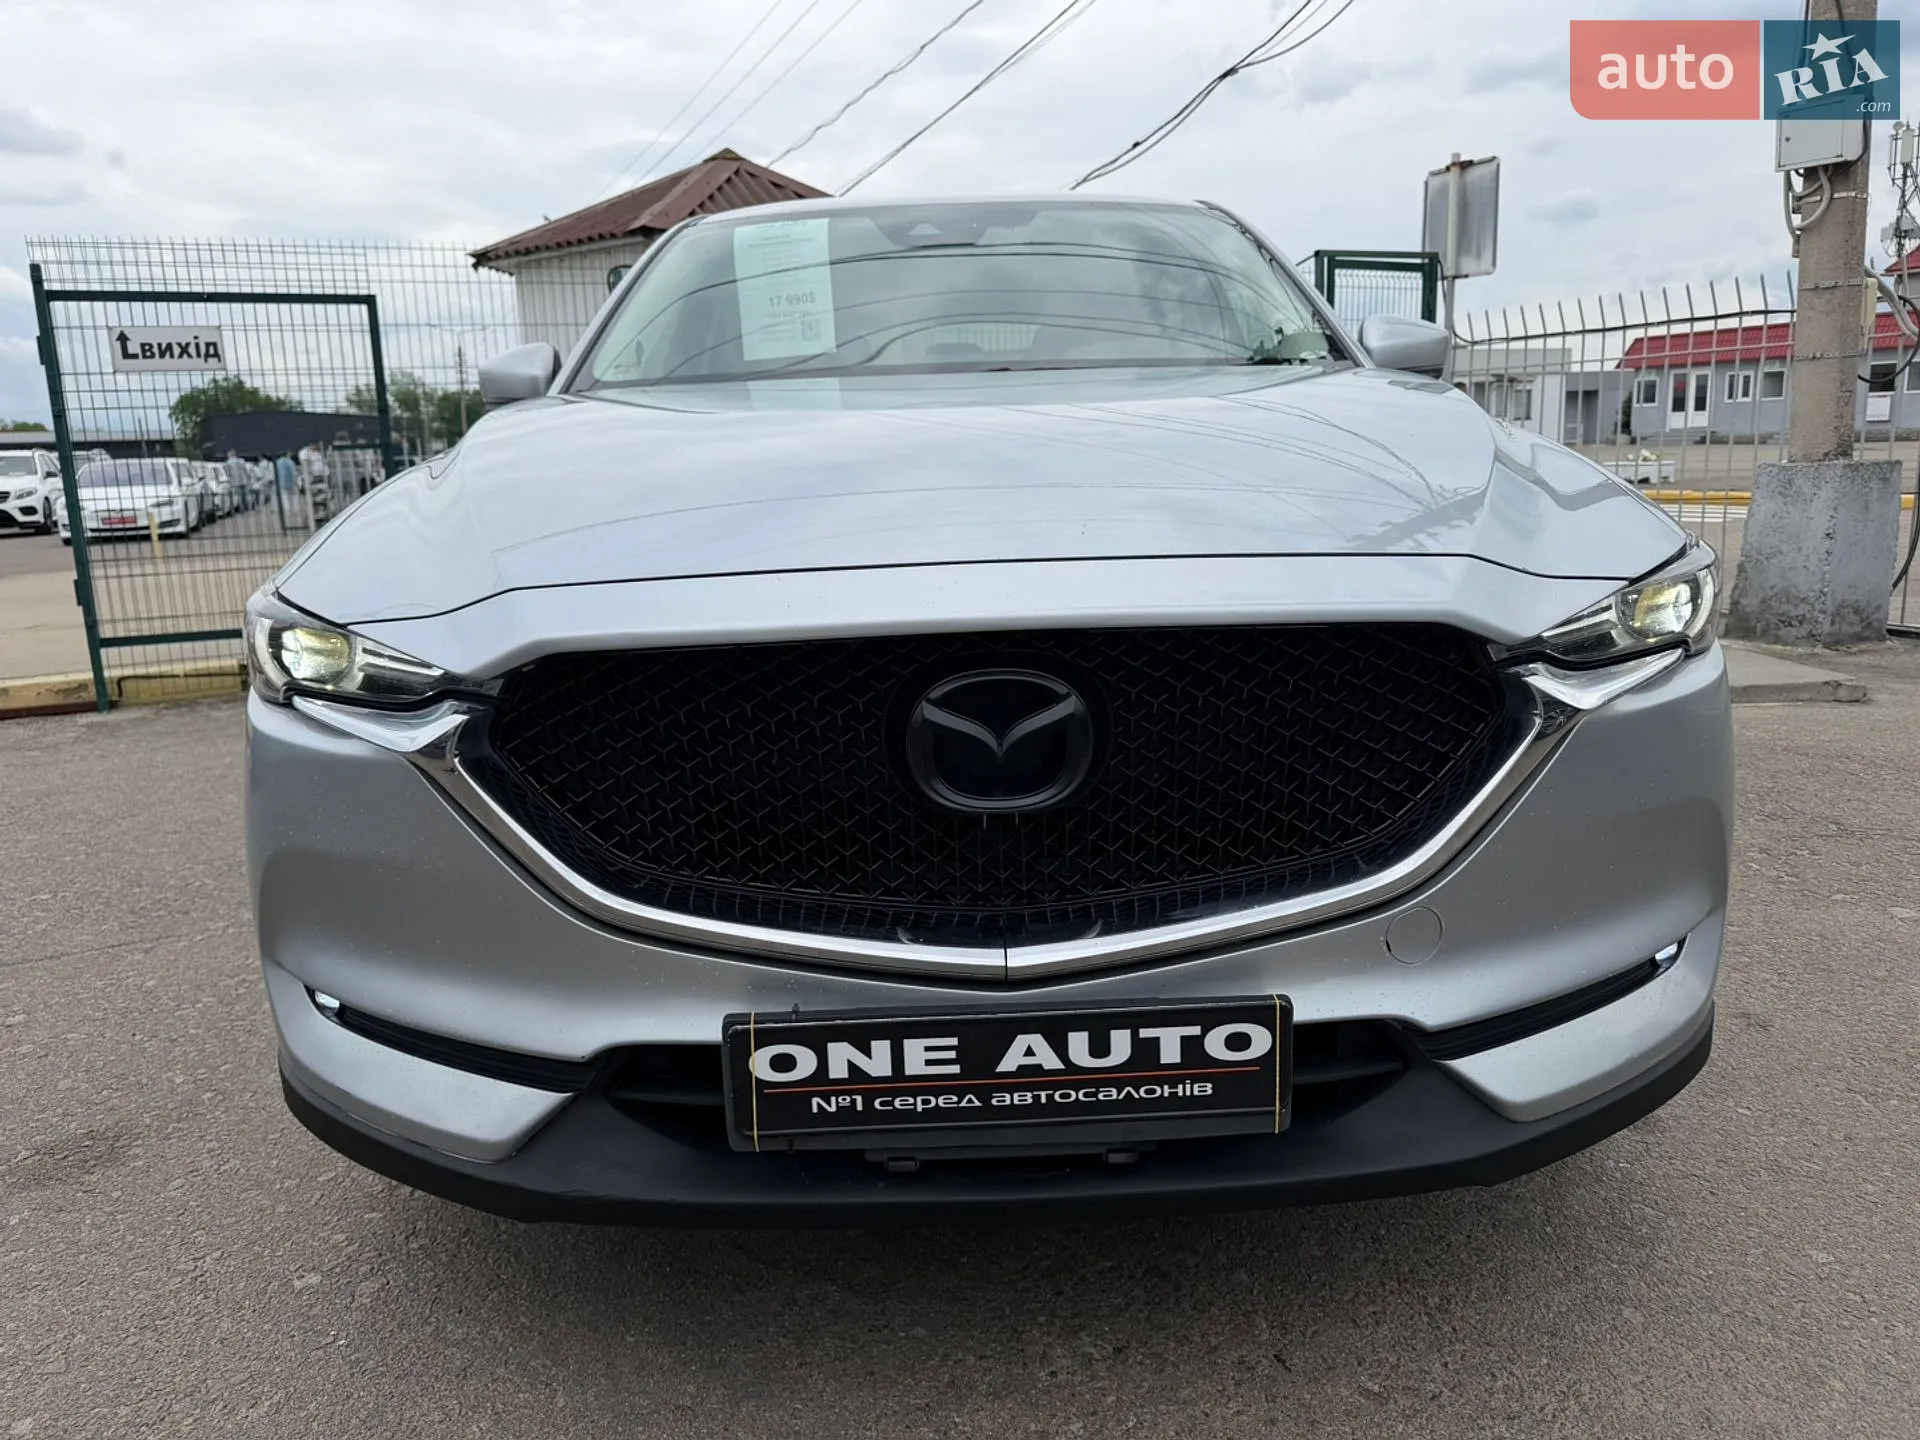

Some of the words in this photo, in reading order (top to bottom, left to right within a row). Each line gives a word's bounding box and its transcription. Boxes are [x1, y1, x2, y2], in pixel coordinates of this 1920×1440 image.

[139, 335, 222, 364] вихід
[748, 1036, 961, 1083] ONE
[994, 1022, 1273, 1073] AUTO
[873, 1093, 983, 1112] серед
[990, 1080, 1214, 1106] автосалонів
